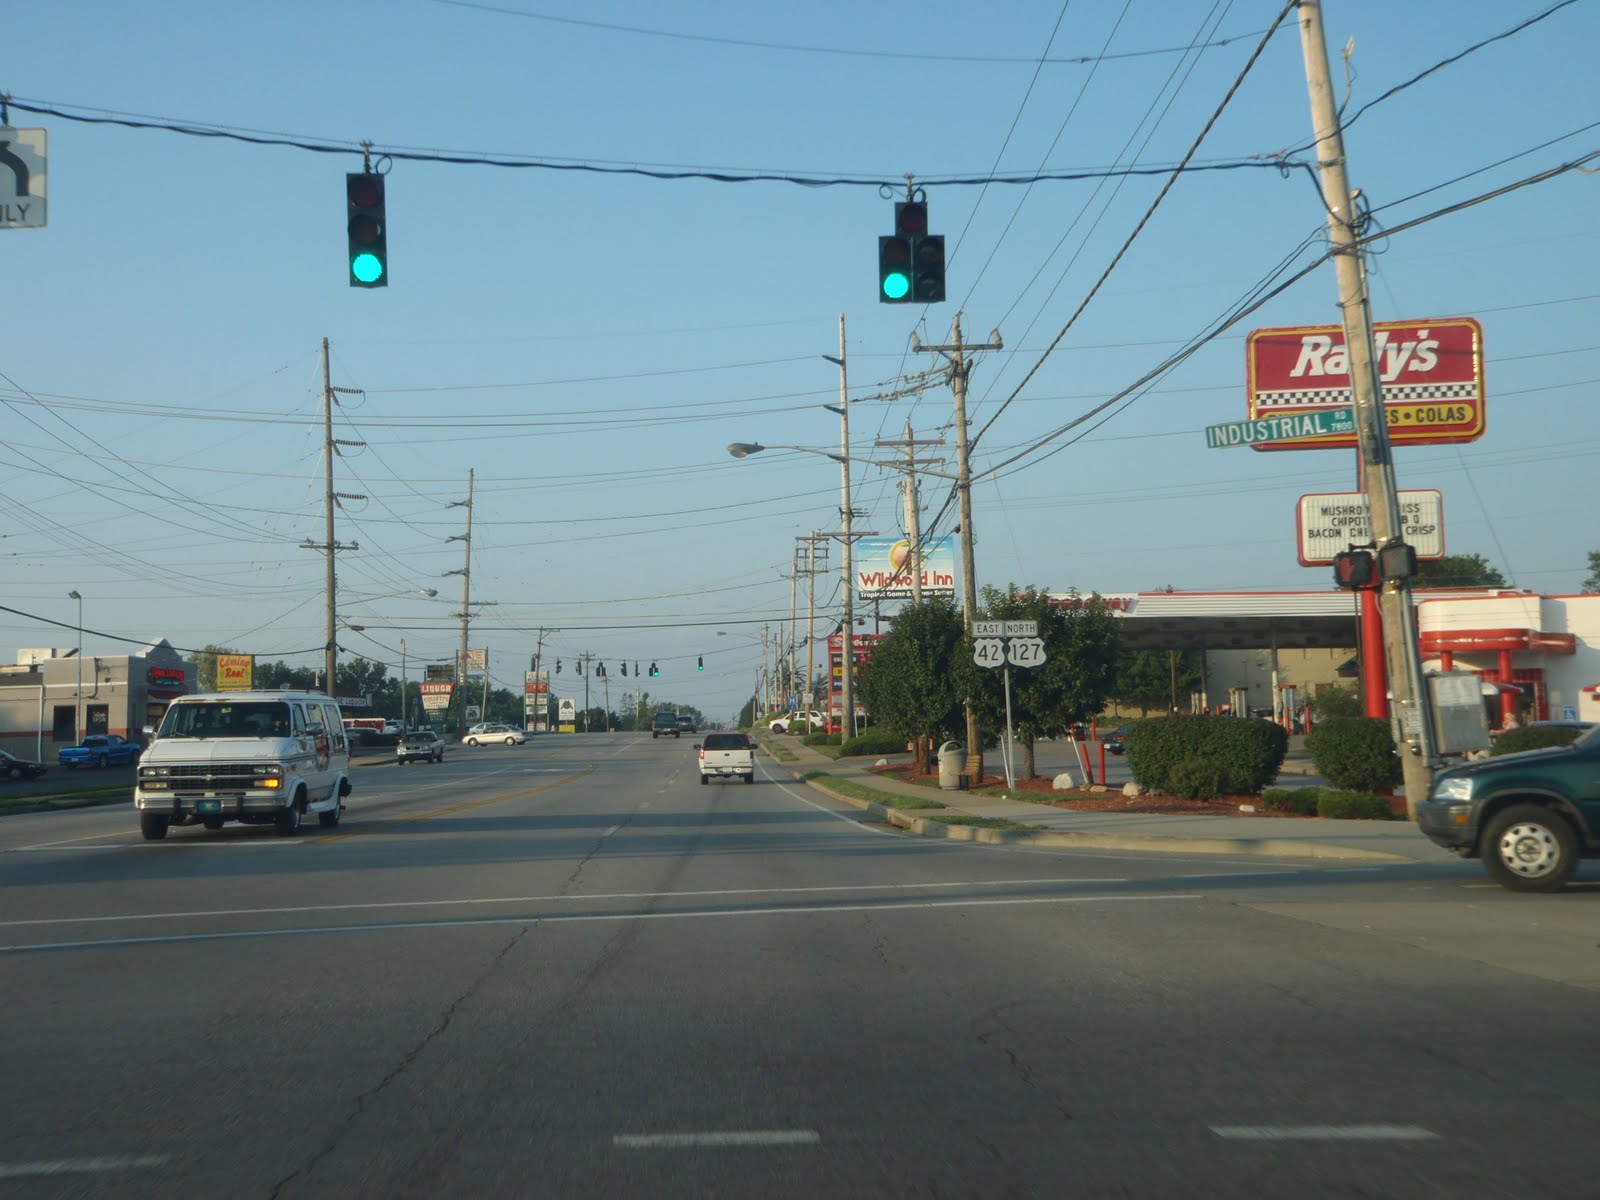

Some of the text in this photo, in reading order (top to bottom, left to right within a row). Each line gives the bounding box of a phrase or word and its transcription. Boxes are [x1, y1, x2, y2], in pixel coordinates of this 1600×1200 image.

[0, 203, 30, 222] LY
[1416, 406, 1466, 424] COLAS
[1208, 416, 1327, 447] INDUSTRIAL
[1333, 410, 1347, 420] RD
[1308, 528, 1342, 539] BACON
[1405, 525, 1436, 535] CRISP
[933, 570, 954, 586] Inn
[977, 623, 1036, 634] EAST NORTH
[978, 644, 999, 661] 42
[1012, 643, 1041, 660] 127
[225, 667, 246, 679] Real
[421, 684, 452, 693] LIQUOR
